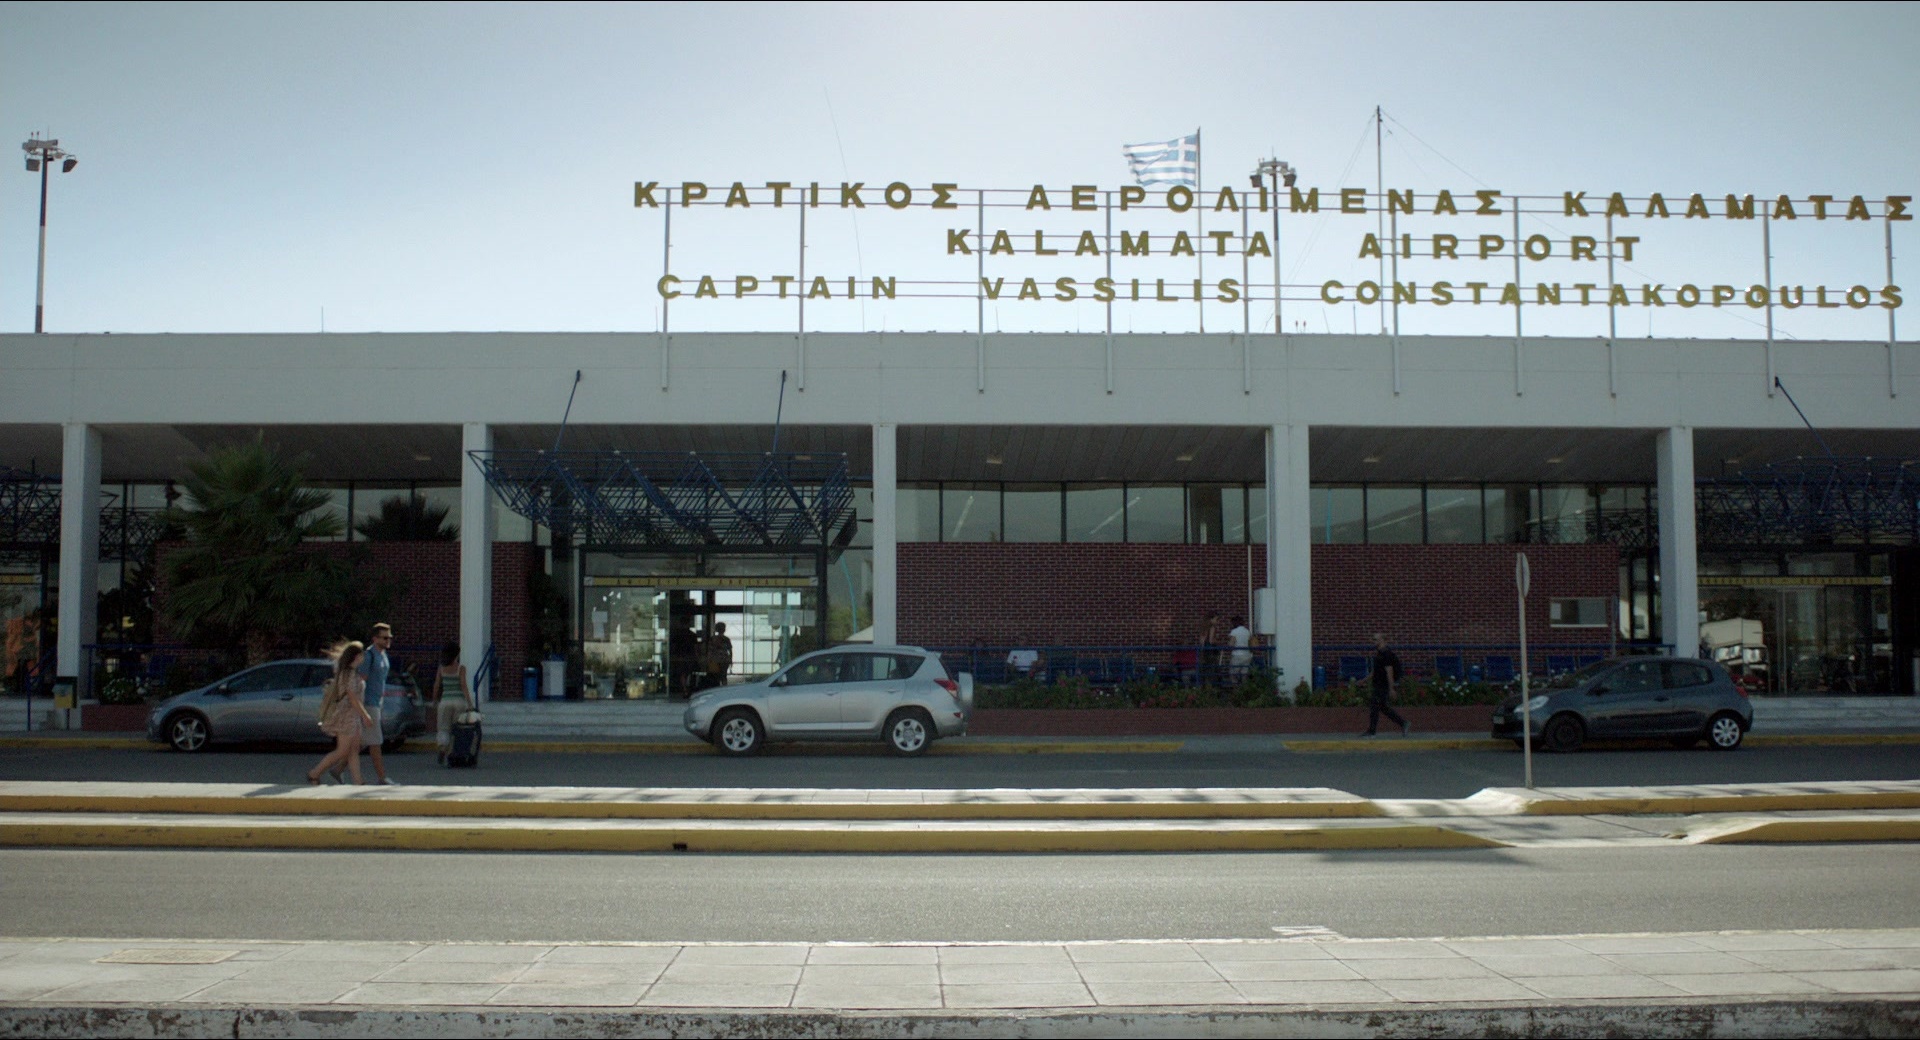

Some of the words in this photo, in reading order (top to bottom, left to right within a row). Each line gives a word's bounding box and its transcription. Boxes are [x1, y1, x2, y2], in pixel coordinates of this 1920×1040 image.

[634, 181, 958, 210] ΚΡΑΤΙΚΟΣ
[1026, 185, 1502, 217] ΑΕΡΟΛΙΜΕΝΑΣ
[1563, 191, 1912, 222] ΚΑΛΑΜΑΤΑΣ
[947, 229, 1272, 257] KALAMATA
[1359, 233, 1640, 262] AIRPORT
[657, 274, 897, 300] CAPTAIN
[981, 277, 1241, 303] VASSILIS
[1320, 281, 1902, 311] CONSTANTAKOPOULOS
